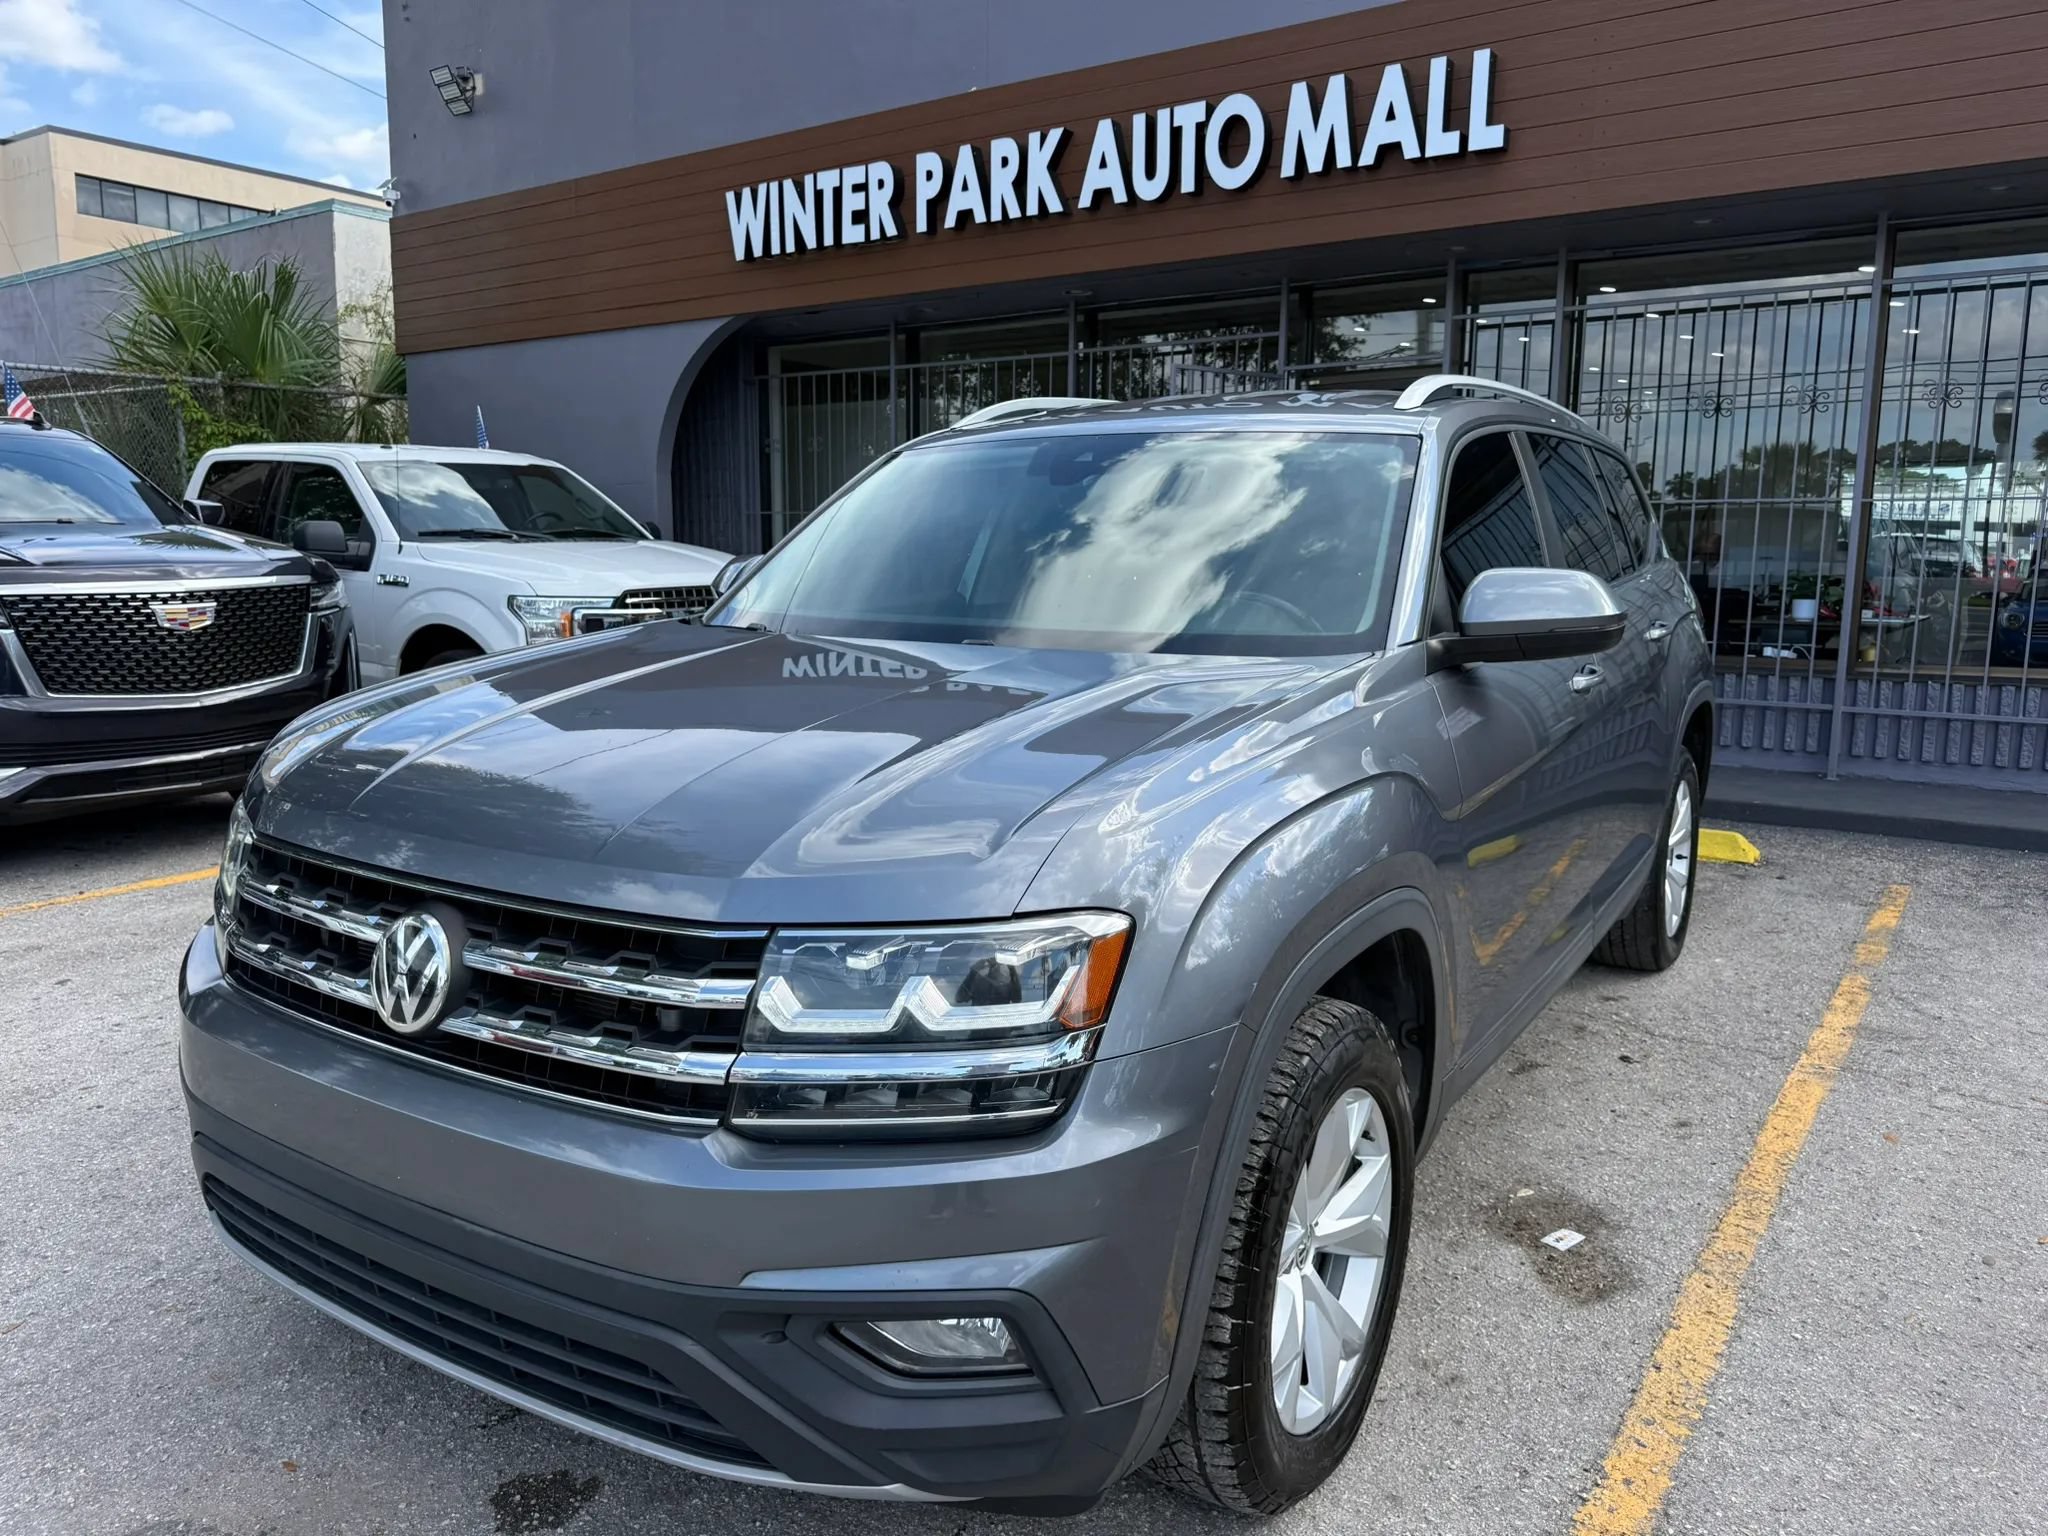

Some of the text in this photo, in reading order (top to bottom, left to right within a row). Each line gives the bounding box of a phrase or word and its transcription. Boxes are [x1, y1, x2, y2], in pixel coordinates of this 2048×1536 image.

[725, 46, 1506, 262] WINTER PARK AUTO MALL
